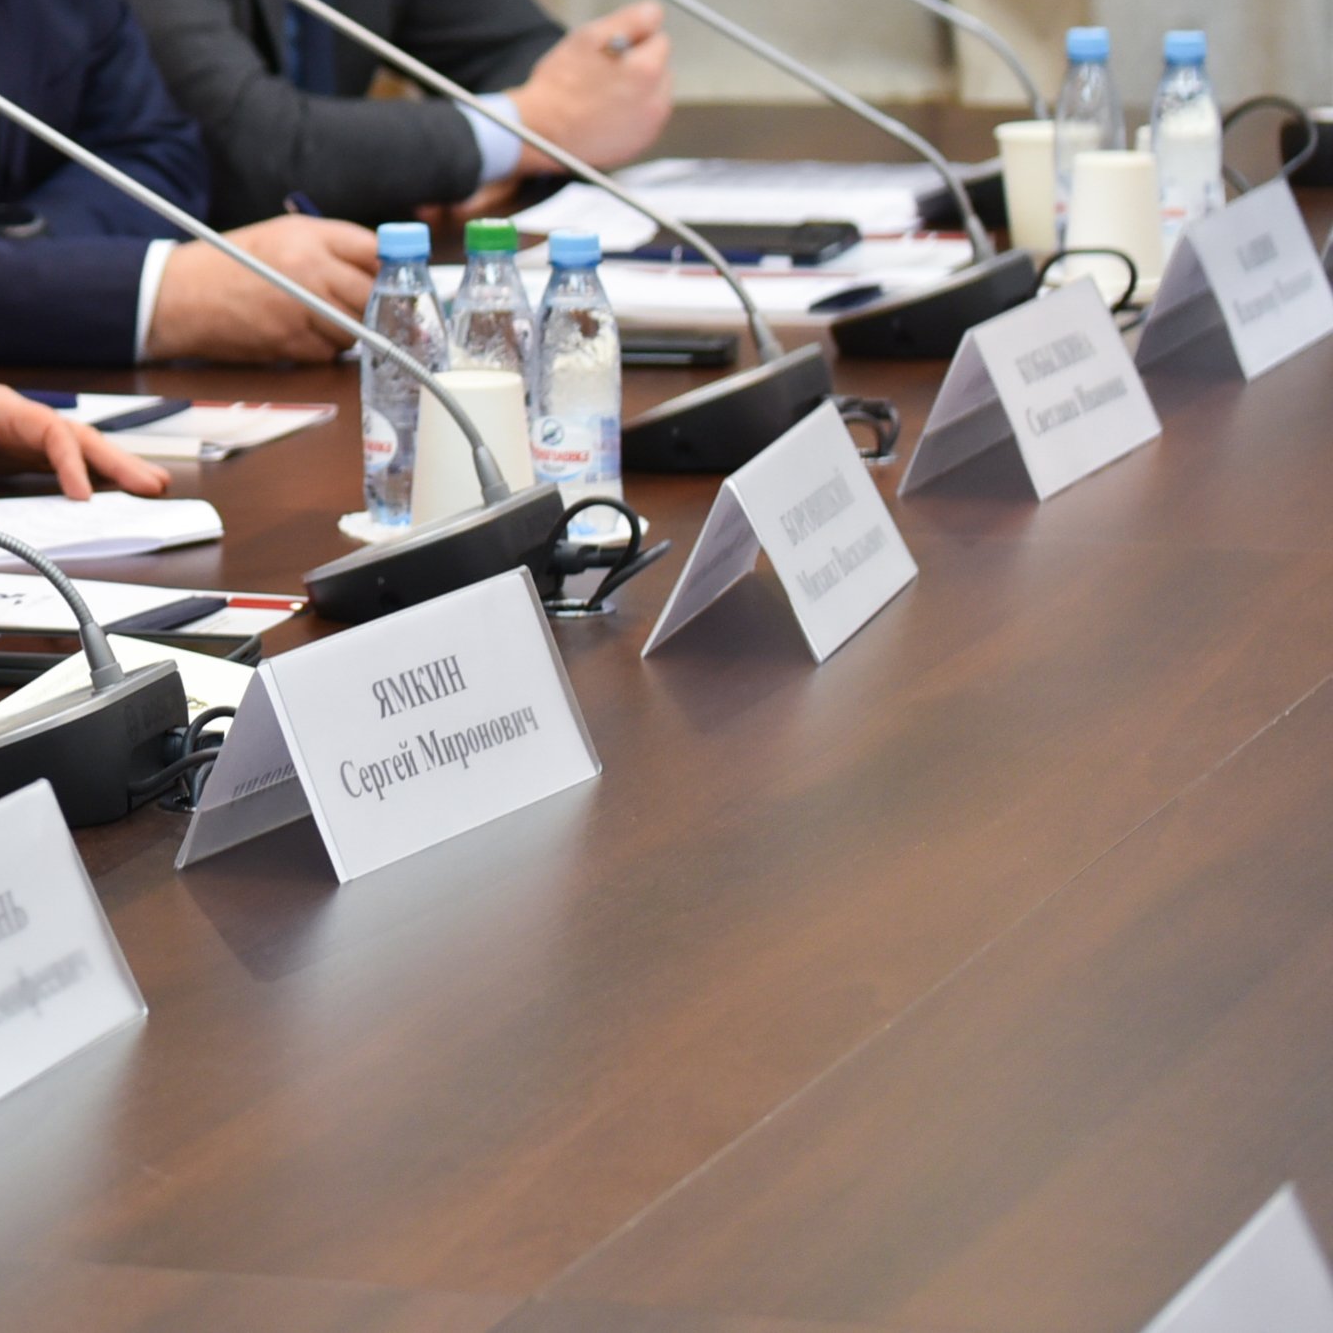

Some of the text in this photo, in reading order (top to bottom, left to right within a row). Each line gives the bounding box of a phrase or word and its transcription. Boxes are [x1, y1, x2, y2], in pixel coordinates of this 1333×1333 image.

[372, 654, 467, 719] ЯМКИН
[339, 740, 420, 801] Сергей
[415, 706, 539, 772] Миронович
